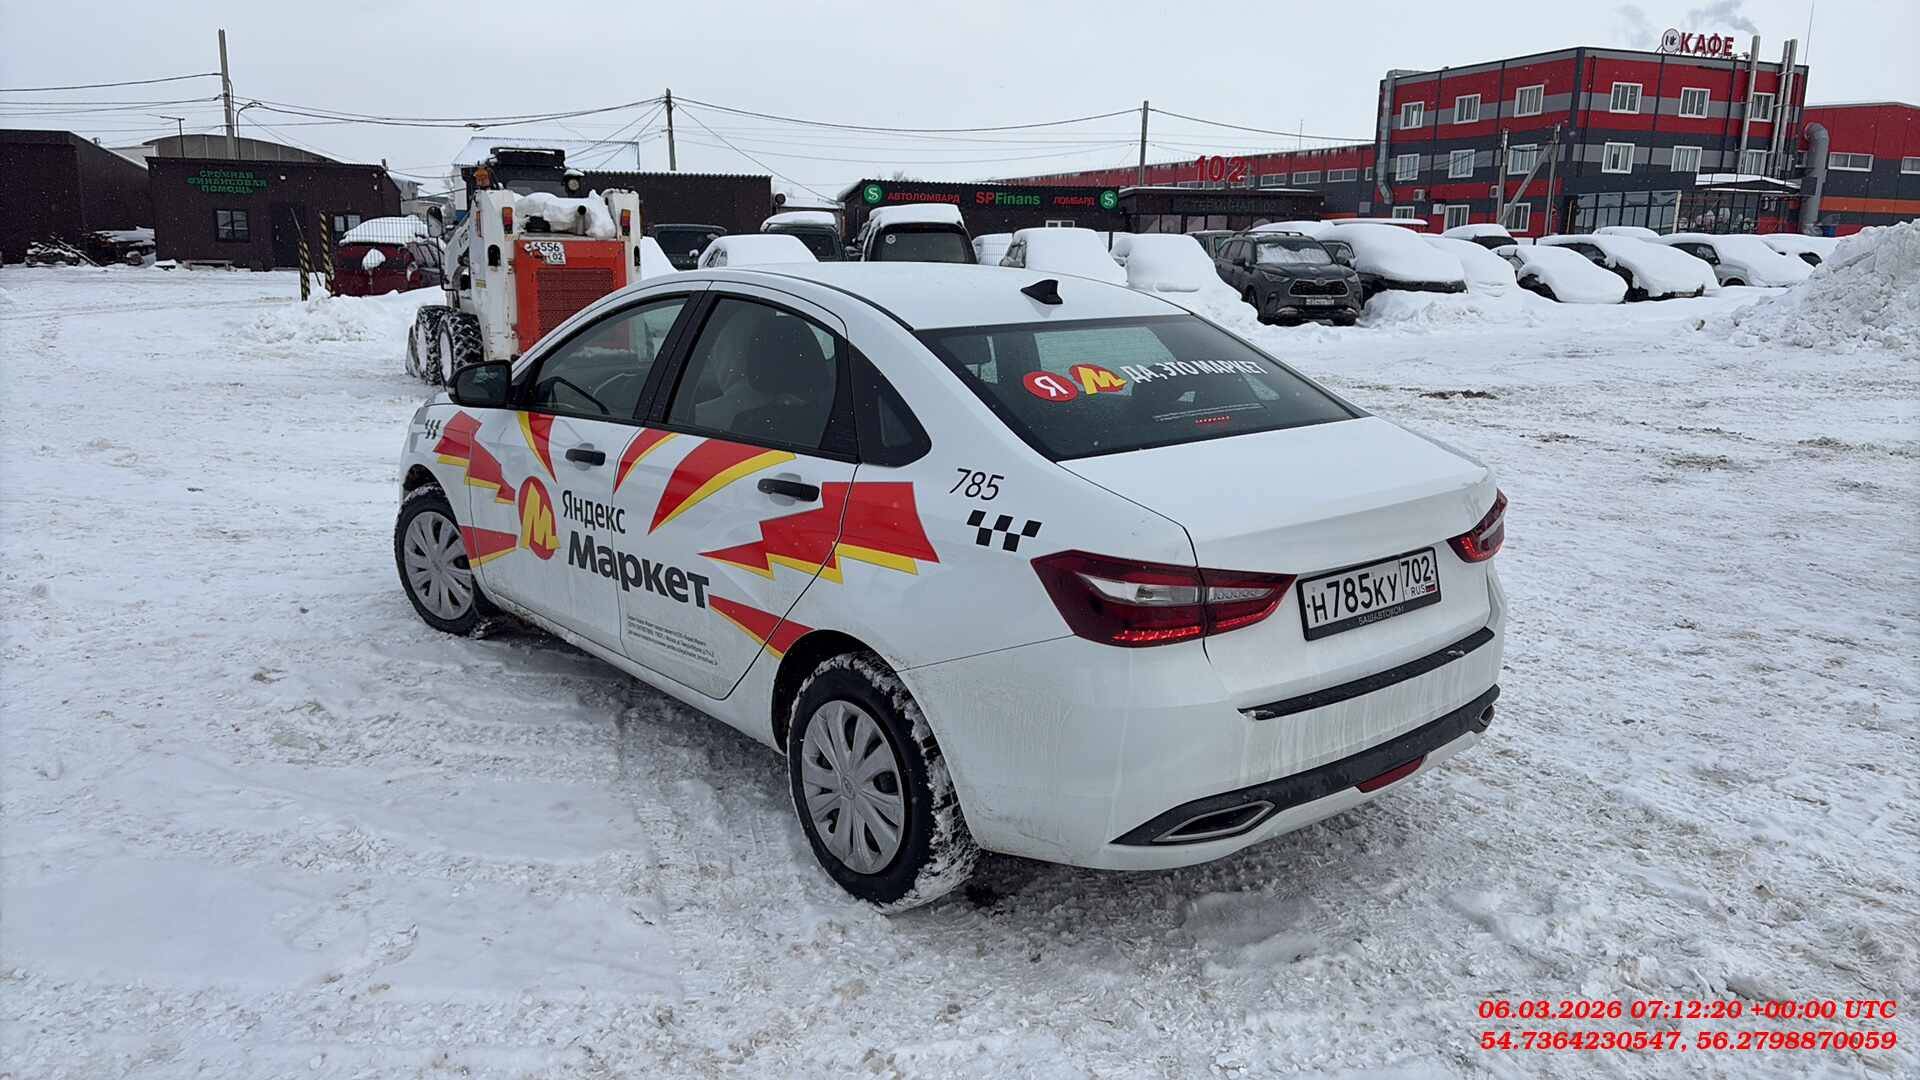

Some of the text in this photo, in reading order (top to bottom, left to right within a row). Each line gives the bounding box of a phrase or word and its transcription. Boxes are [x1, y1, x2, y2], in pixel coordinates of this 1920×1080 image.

[1680, 32, 1734, 56] КАФЕ
[199, 169, 254, 179] СРОЧНАЯ
[1195, 155, 1247, 183] 102
[201, 185, 254, 194] ПОМОЩЬ
[887, 192, 961, 204] АВТОЛОМБАРД
[975, 191, 1041, 206] SPFinans
[1054, 196, 1095, 206] ЛОМБАРД
[1119, 363, 1168, 384] ДА,
[1155, 361, 1199, 377] ЭТО
[1190, 359, 1269, 375] МАРКЕТ
[949, 467, 1005, 501] 785
[562, 489, 626, 534] Яндекс
[568, 530, 709, 609] Маркет
[1311, 556, 1431, 624] Н785КУ 702
[1410, 585, 1426, 598] RUS
